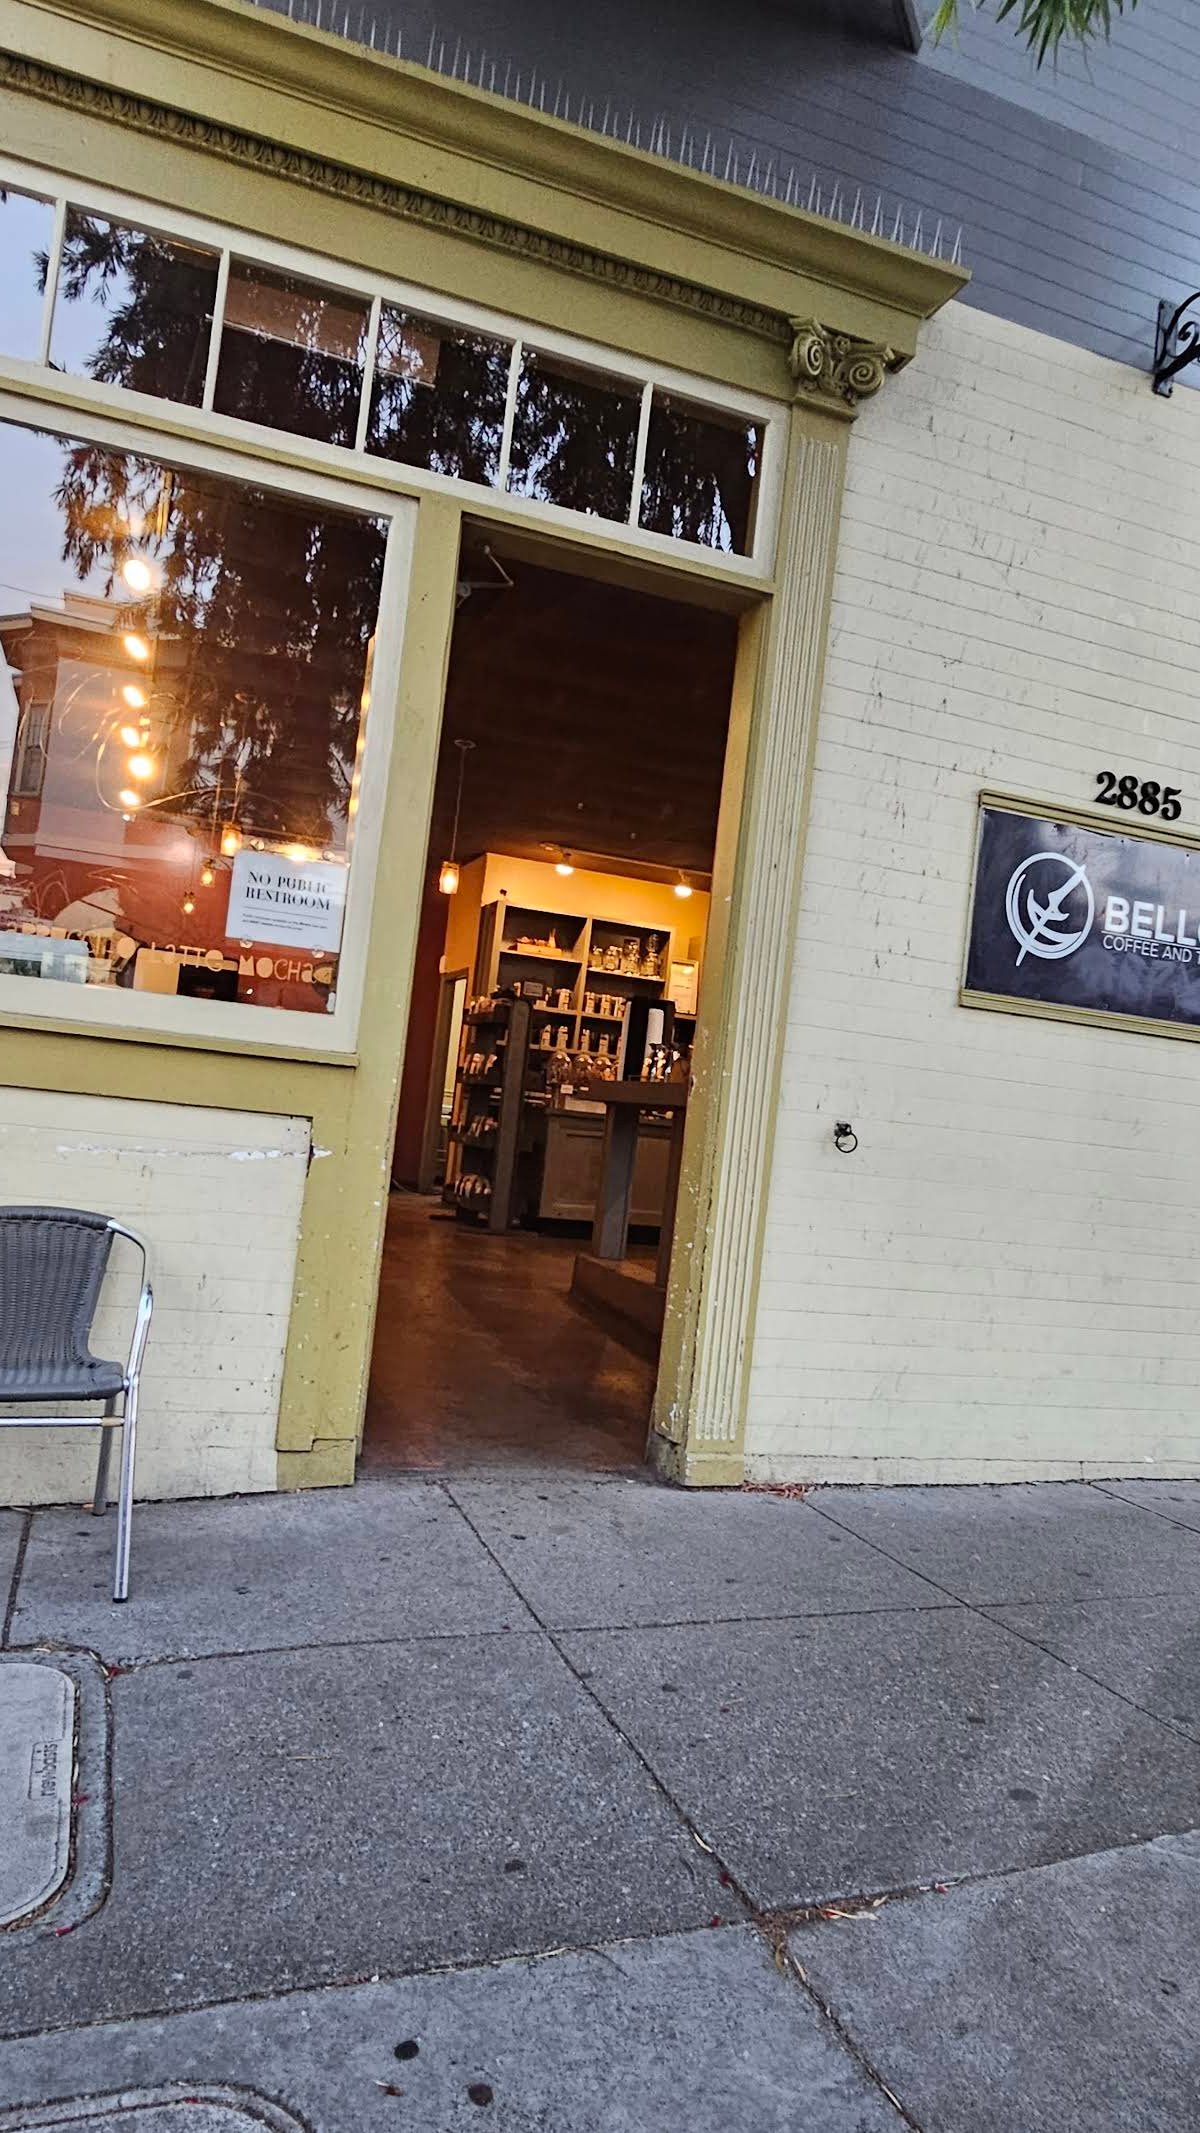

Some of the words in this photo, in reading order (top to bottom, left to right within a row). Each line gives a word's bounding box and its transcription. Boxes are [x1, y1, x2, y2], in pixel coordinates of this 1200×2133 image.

[1095, 771, 1182, 820] 2885
[248, 871, 272, 885] NO
[278, 875, 329, 894] PUBLIC
[246, 886, 330, 911] RESTROOM
[1104, 895, 1200, 947] BELL
[1103, 935, 1160, 958] COFFEE
[1161, 945, 1193, 963] AND
